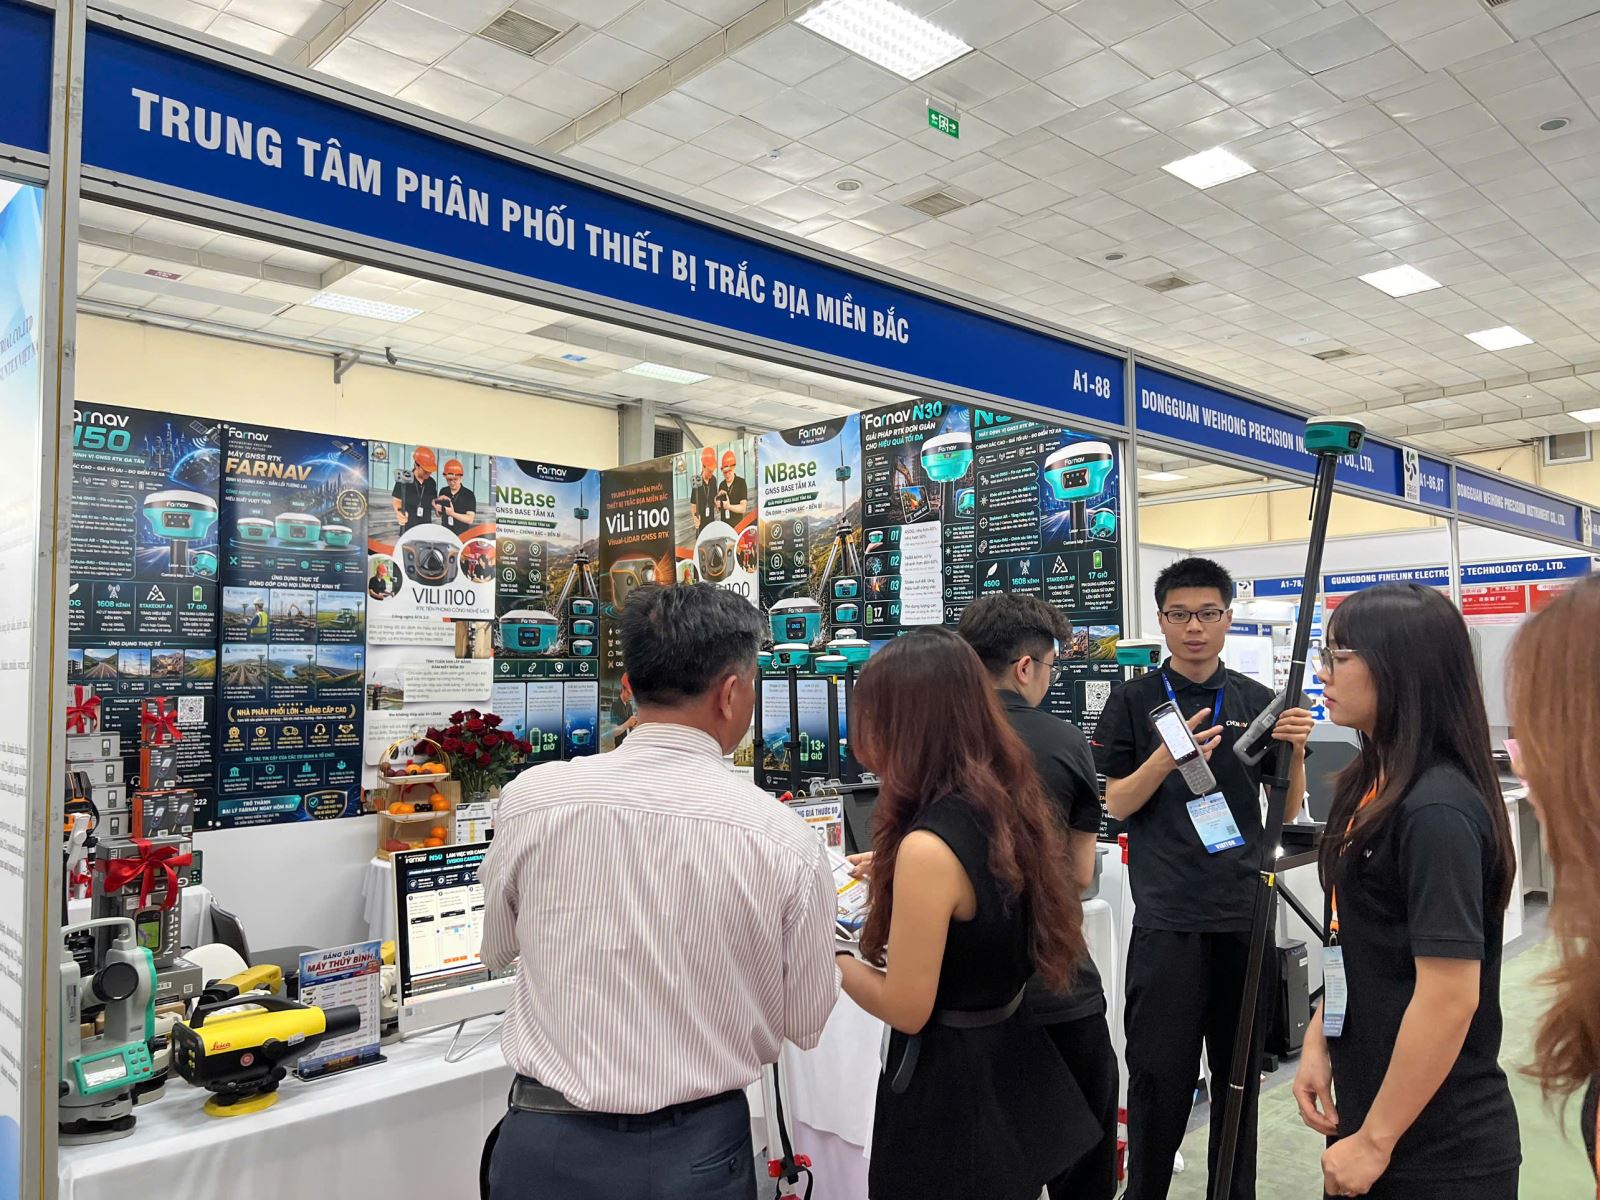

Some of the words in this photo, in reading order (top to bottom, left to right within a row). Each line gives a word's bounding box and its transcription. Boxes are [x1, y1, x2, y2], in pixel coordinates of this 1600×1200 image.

[131, 88, 282, 168] TRUNG
[297, 138, 382, 196] TÂM
[397, 167, 489, 226] PHÂN
[502, 197, 575, 250] PHỐI
[585, 223, 663, 274] THIẾT
[672, 249, 696, 291] BỊ
[705, 260, 765, 304] TRẮC
[773, 280, 810, 319] ĐỊA
[817, 292, 866, 333] MIỀN
[873, 306, 909, 344] BẮC
[1073, 369, 1111, 399] A1-88
[74, 410, 130, 428] arnav
[866, 409, 911, 430] Farnav
[912, 401, 943, 420] N30
[228, 427, 269, 442] Farnav
[799, 426, 826, 440] Farnav
[866, 432, 877, 441] GIẢI
[878, 429, 893, 439] PHÁP
[893, 427, 905, 436] RTK
[906, 424, 918, 433] ĐƠN
[919, 422, 936, 431] GIẢN
[1142, 388, 1200, 424] DONGGUAN
[1202, 406, 1247, 437] WEIHONG
[1249, 419, 1294, 451] PRECISION
[1360, 455, 1374, 473] LTD.
[878, 440, 891, 449] HIỆU
[892, 438, 905, 446] QUẢ
[906, 435, 914, 443] TỐI
[245, 452, 266, 460] GNSS
[267, 454, 282, 462] RTK
[1064, 456, 1085, 465] Farnav
[225, 457, 312, 481] FARNAV
[537, 465, 567, 476] Farnav
[765, 460, 817, 484] NBase
[765, 487, 780, 495] GNSS
[781, 484, 794, 492] BASE
[496, 486, 556, 508] NBase
[1456, 483, 1482, 502] DONGGUAN
[1483, 490, 1504, 509] WEIHONG
[1504, 496, 1526, 514] PRECISION
[1526, 504, 1550, 521] INSTRUMENT
[606, 510, 633, 534] ViLi
[638, 507, 670, 530] i100
[890, 530, 899, 540] 01
[890, 556, 899, 566] 02
[1331, 574, 1376, 586] GUANGDONG
[1378, 572, 1413, 582] FINELINK
[1415, 568, 1464, 579] ELECTROC
[1467, 564, 1523, 576] TECHNOLOGY
[1526, 562, 1545, 573] CO.,
[1546, 561, 1566, 571] LTD.
[890, 581, 899, 590] 03
[412, 588, 440, 604] VILI
[874, 608, 883, 617] 17
[890, 604, 900, 615] 04
[237, 708, 250, 716] NHÀ
[252, 707, 270, 716] PHÂN
[270, 706, 285, 715] PHỐI
[542, 733, 558, 743] 13+
[810, 740, 826, 751] 13+
[805, 808, 814, 817] GIÁ
[307, 960, 326, 973] MÁY
[353, 953, 374, 963] BÌNH
[323, 952, 342, 960] BẢNG
[210, 1041, 231, 1051] Leica
